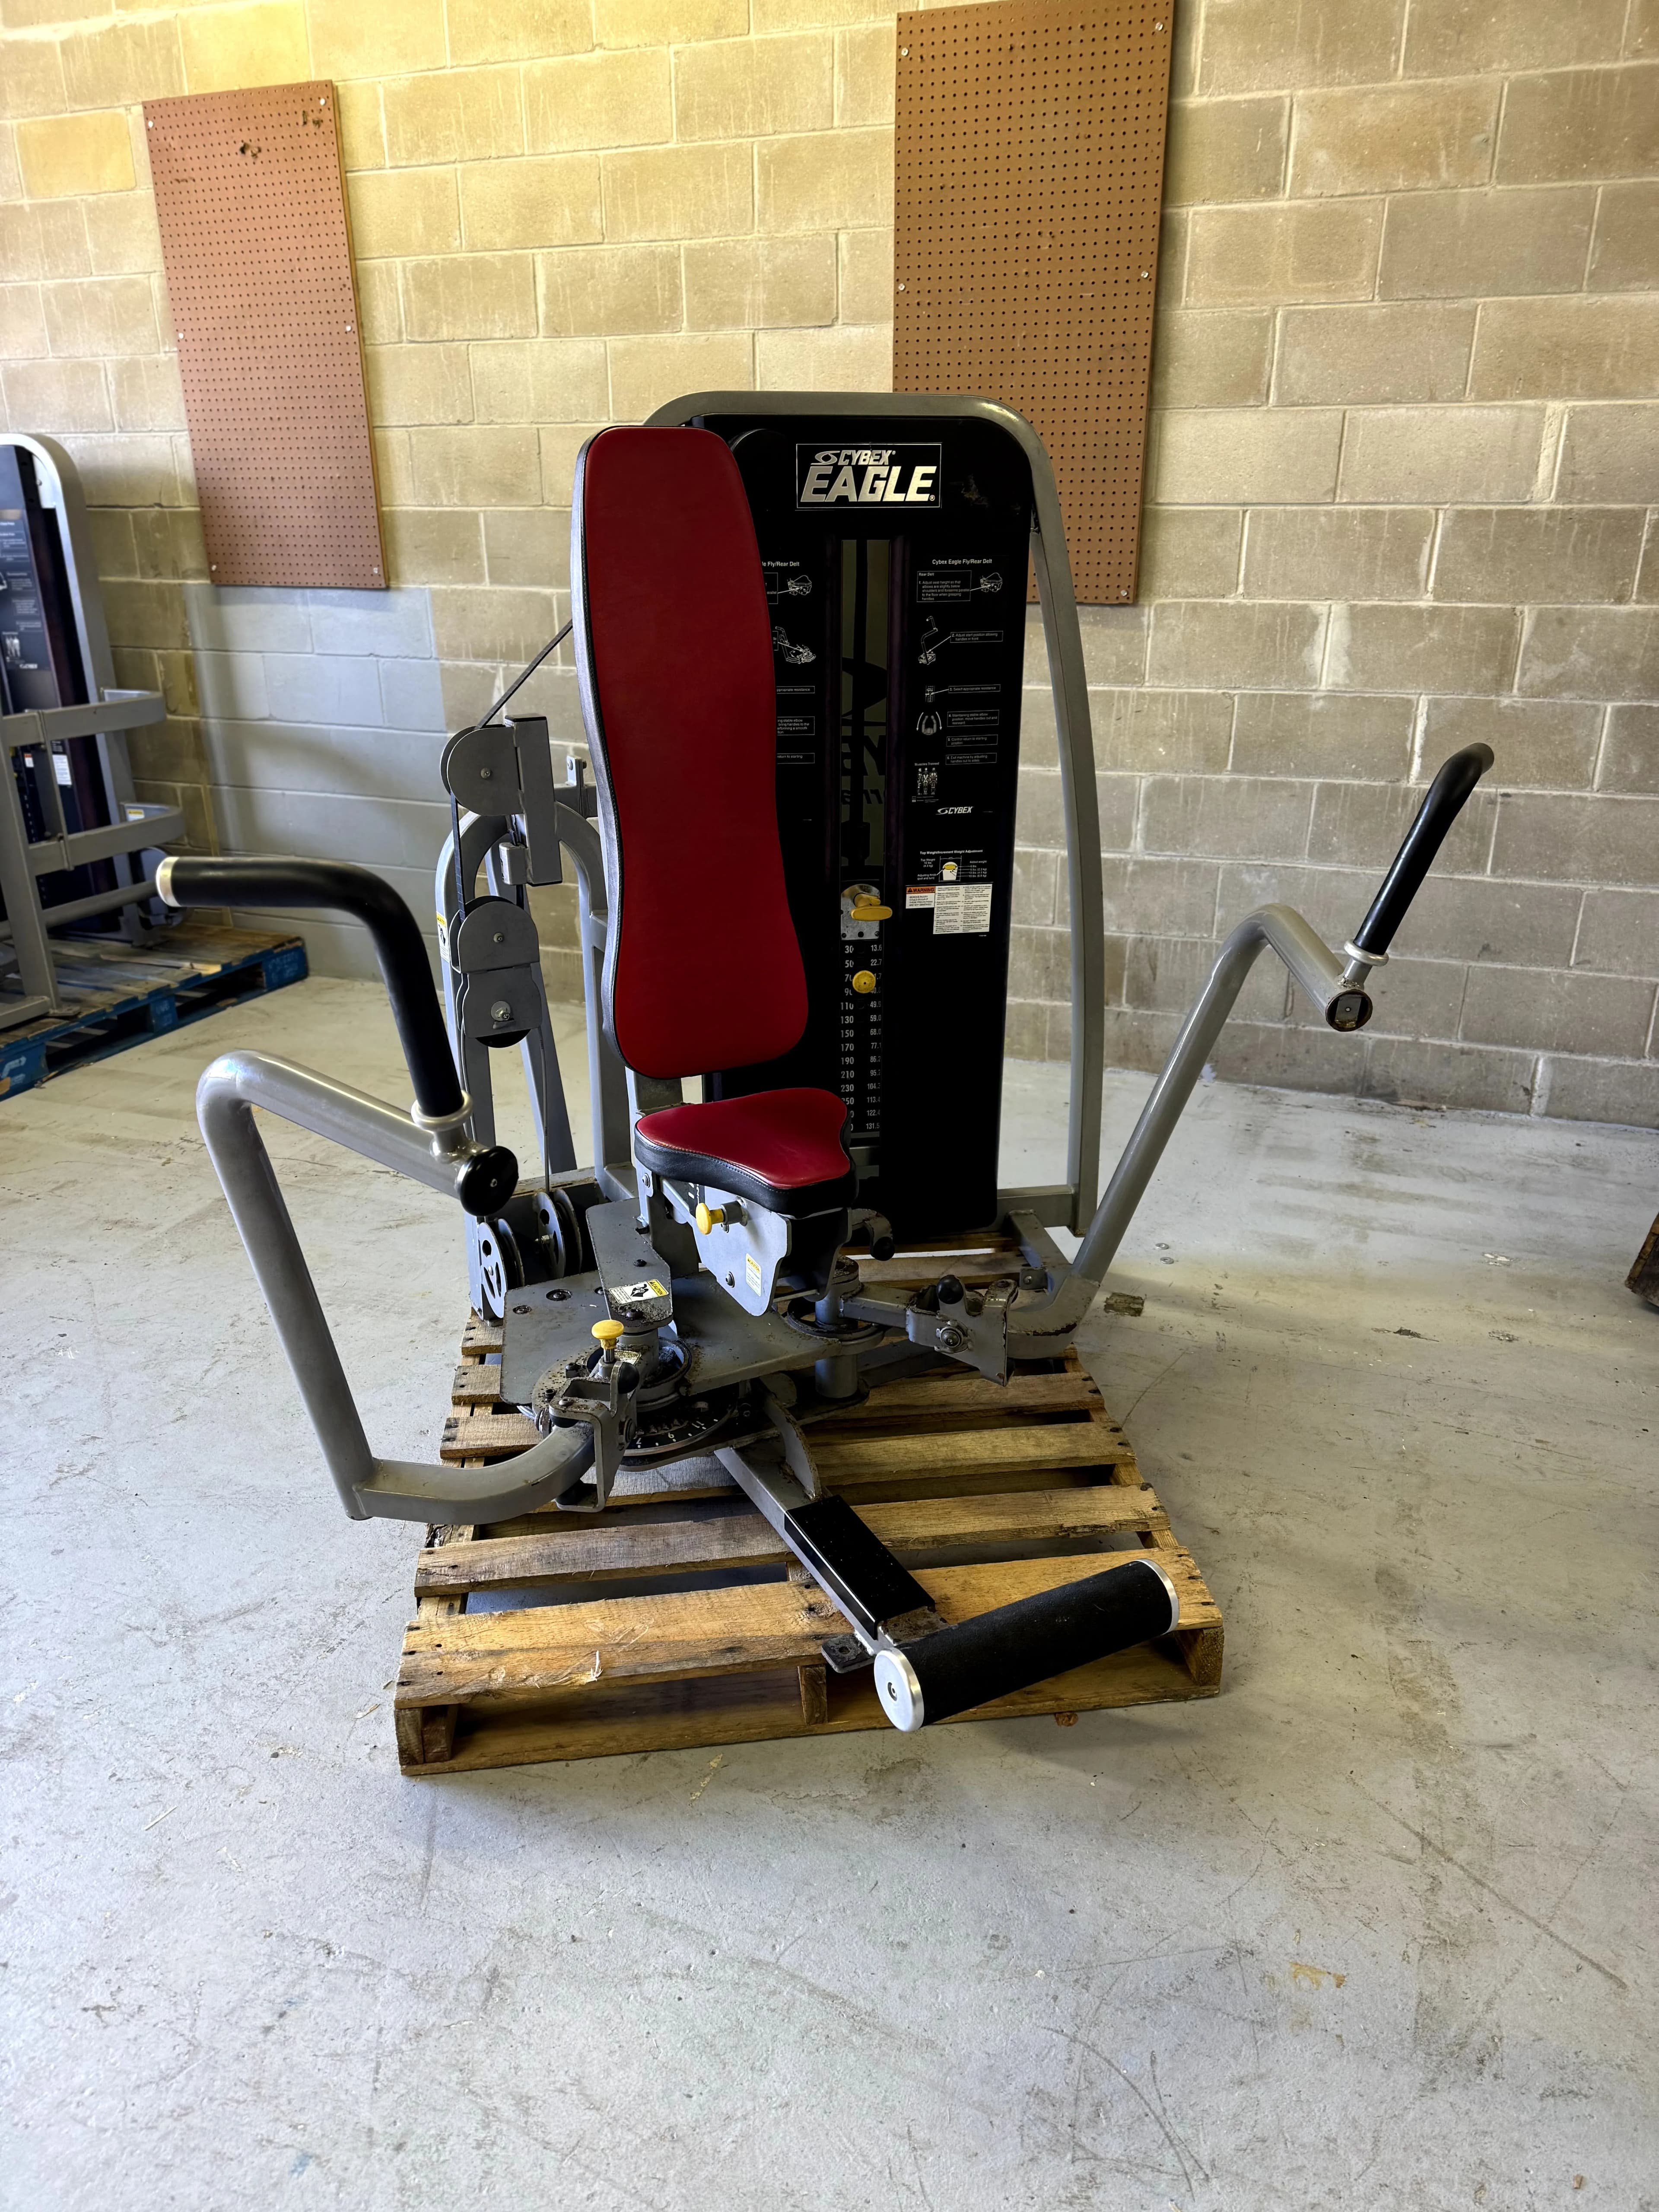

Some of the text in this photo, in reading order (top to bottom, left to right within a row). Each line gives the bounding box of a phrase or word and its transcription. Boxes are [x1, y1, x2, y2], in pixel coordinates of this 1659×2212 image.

[838, 450, 893, 465] CYBEX
[800, 466, 937, 502] EAGLE
[948, 806, 974, 814] CYBEX
[845, 945, 854, 953] 30
[841, 1016, 854, 1024] 130
[841, 1030, 854, 1038] 150
[841, 1043, 854, 1052] 170
[841, 1070, 855, 1079] 210
[841, 1084, 854, 1092] 230
